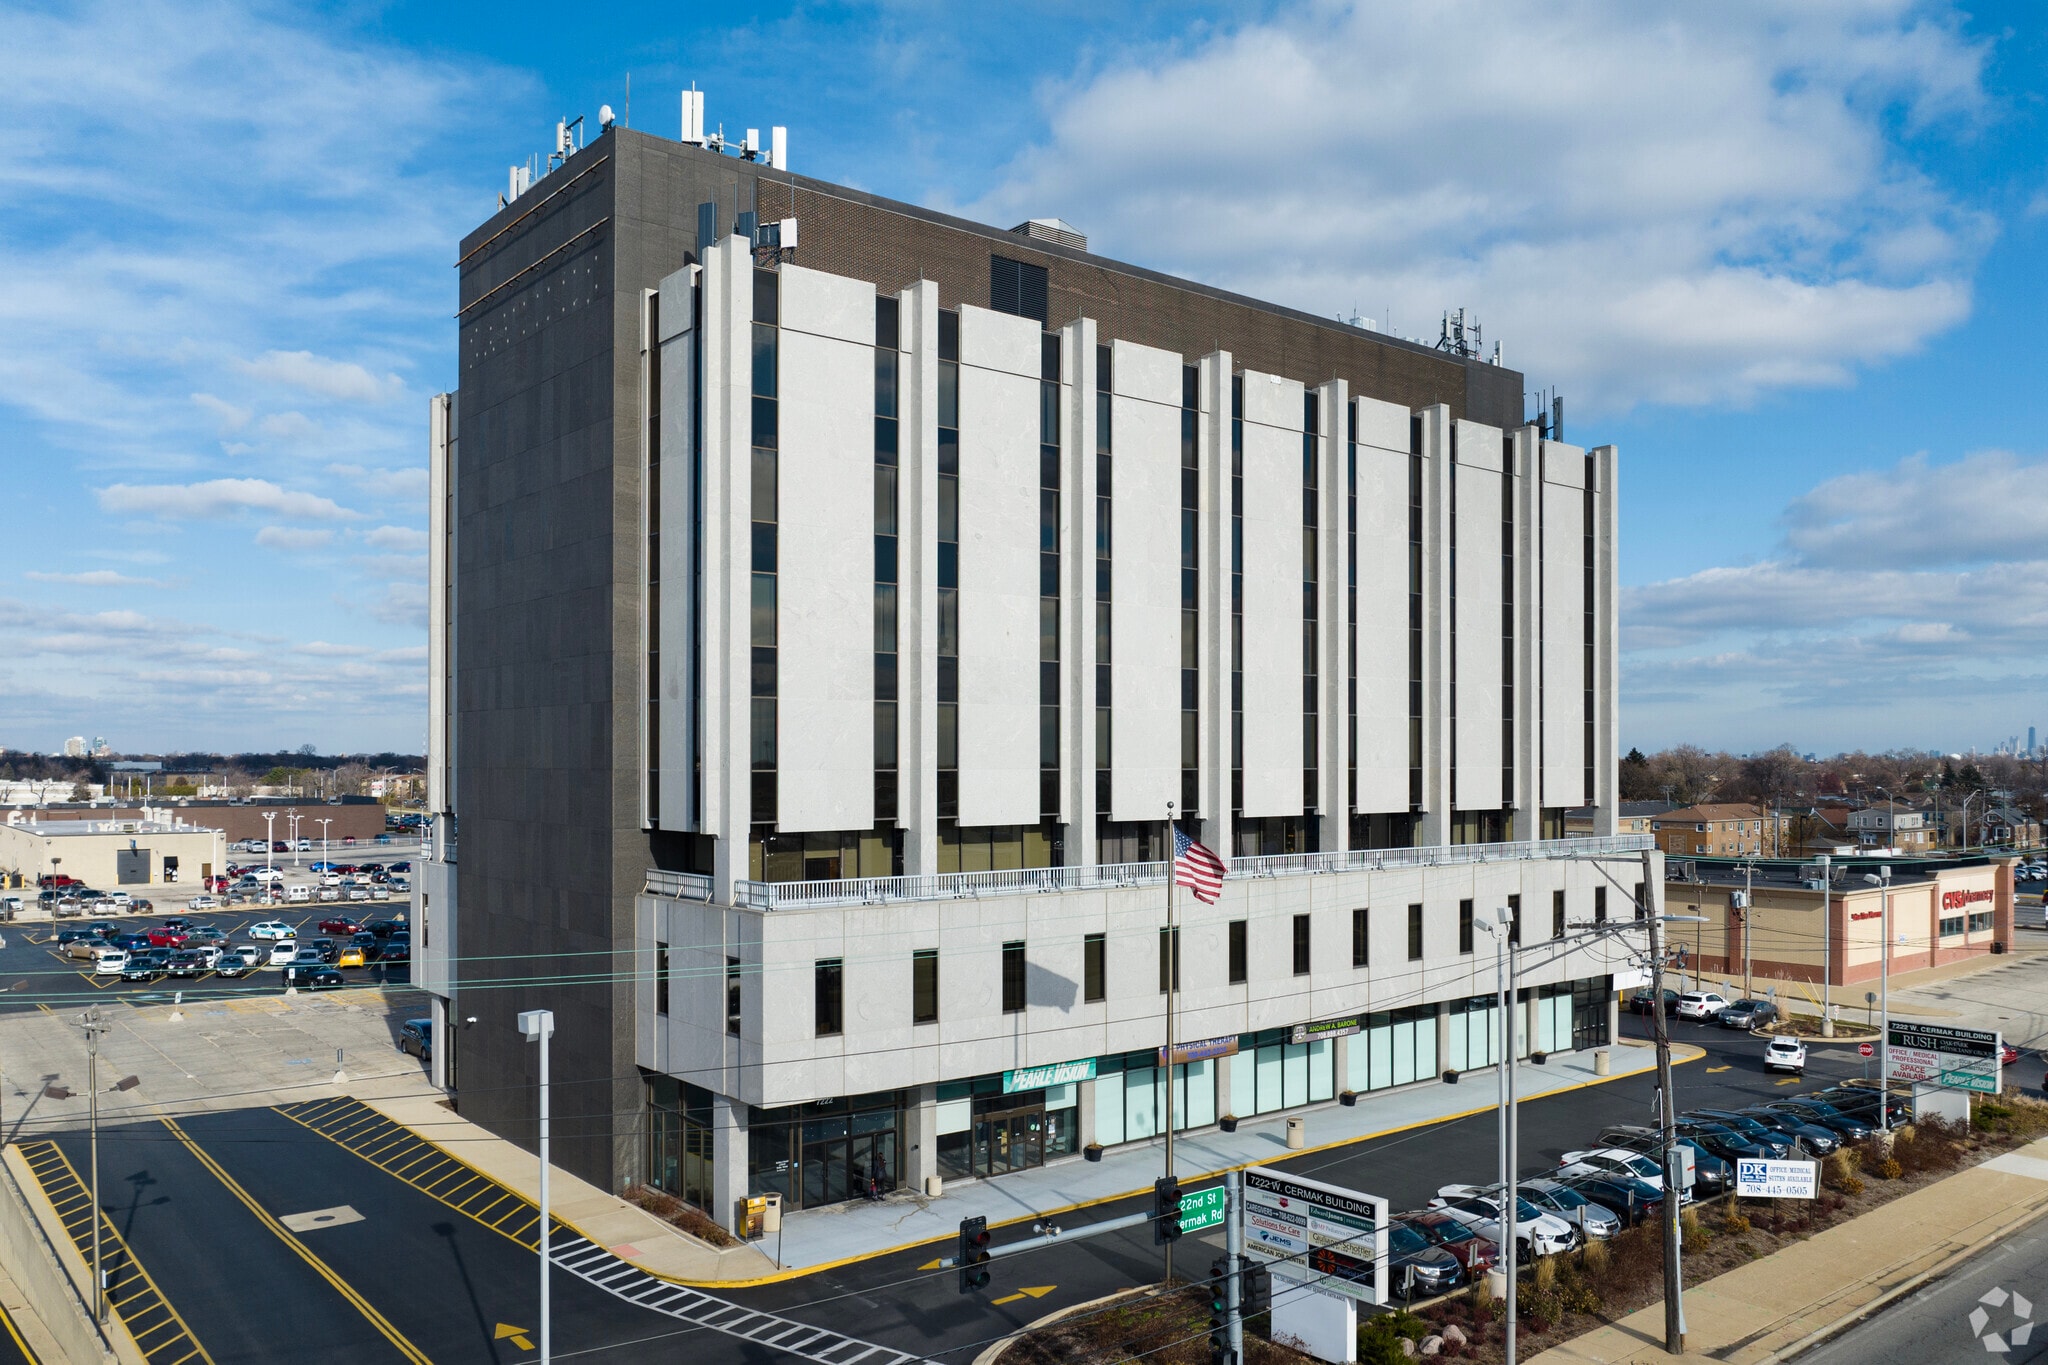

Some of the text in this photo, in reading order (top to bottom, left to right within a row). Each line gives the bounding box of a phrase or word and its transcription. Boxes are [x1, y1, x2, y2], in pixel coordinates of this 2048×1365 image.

[1943, 889, 1994, 910] CVS/pharmacy
[1309, 1024, 1331, 1033] ANDREW
[1337, 1019, 1357, 1028] BARONE
[1892, 1023, 1908, 1031] 7222
[1921, 1026, 1953, 1037] CERMAK
[1955, 1031, 1993, 1041] BUILDING
[1176, 1035, 1237, 1051] PHYSICAL THERAPY
[1903, 1034, 1939, 1050] RUSH
[1889, 1048, 1907, 1056] OFFICE
[1913, 1051, 1938, 1060] MEDICAL
[1892, 1055, 1934, 1066] PROFESSIONAL
[1009, 1061, 1091, 1091] PEARLE VISION
[1900, 1064, 1925, 1074] SPACE
[1970, 1074, 1996, 1090] VISION
[1741, 1163, 1766, 1175] DK
[1770, 1166, 1787, 1174] OFFICE
[1180, 1192, 1216, 1212] 22nd St
[1250, 1175, 1270, 1189] 7222
[1271, 1181, 1283, 1192] W.
[1284, 1185, 1324, 1203] CERMAK
[1325, 1195, 1371, 1215] BUILDING
[1178, 1208, 1222, 1229] ermak Rd
[1251, 1215, 1301, 1236] Solutions for Care
[1269, 1235, 1292, 1246] JEMS
[1247, 1243, 1275, 1256] AMERICAN
